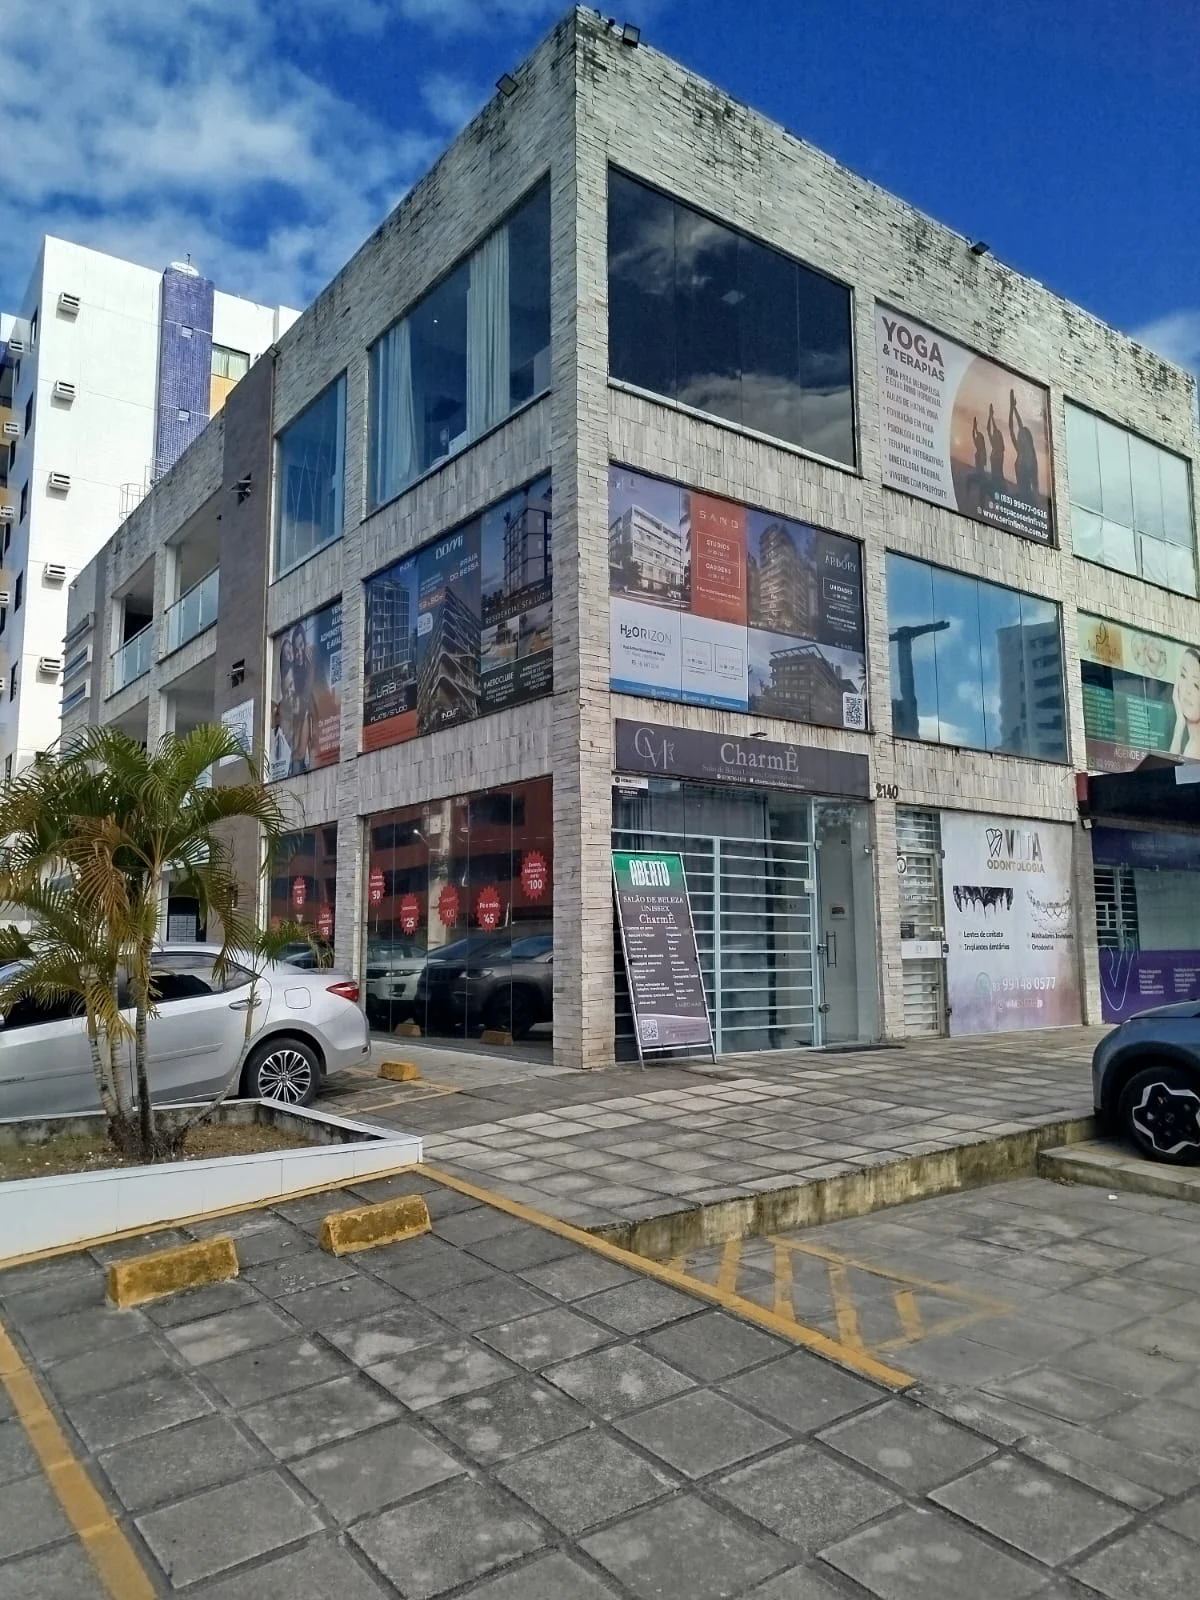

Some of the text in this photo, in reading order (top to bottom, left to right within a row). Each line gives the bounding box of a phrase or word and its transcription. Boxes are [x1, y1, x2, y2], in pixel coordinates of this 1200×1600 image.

[882, 316, 944, 368] YOGA
[882, 343, 945, 382] & TERAPIAS
[720, 742, 799, 773] CharmÊ
[875, 782, 899, 800] 2140
[628, 859, 671, 887] ABERTO
[986, 858, 1046, 874] ODONTOLOGIA
[963, 930, 979, 938] Lentes
